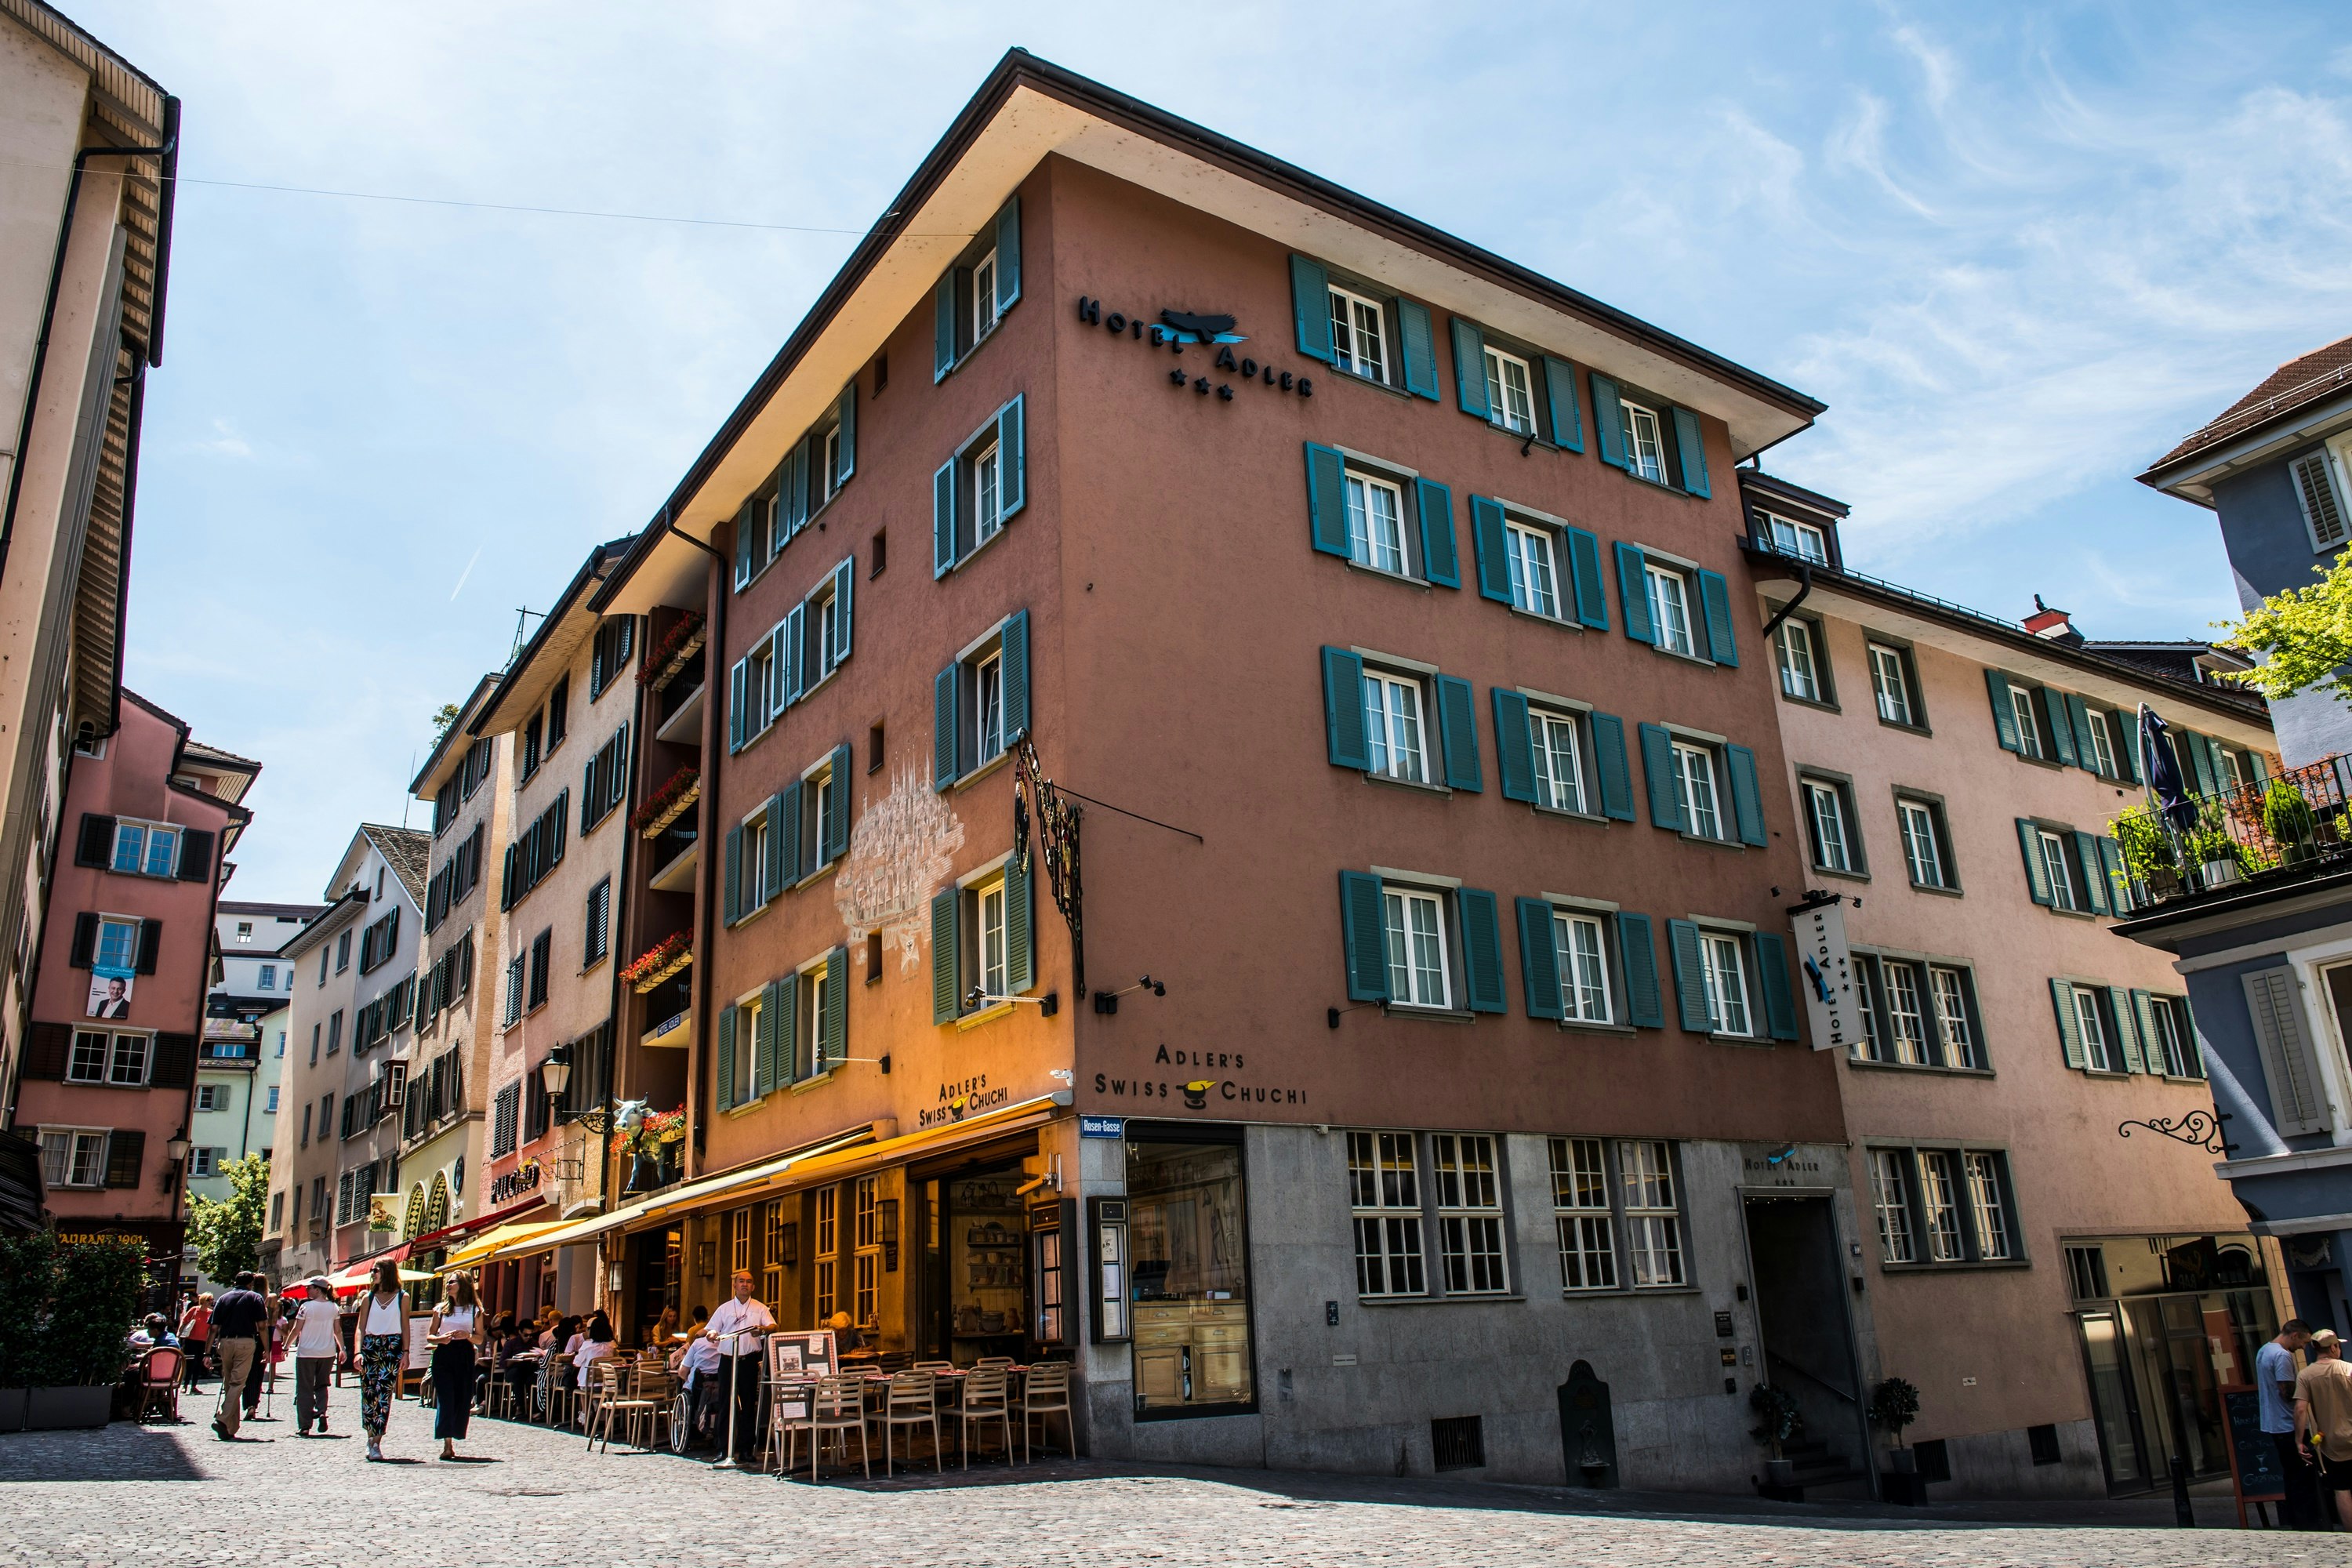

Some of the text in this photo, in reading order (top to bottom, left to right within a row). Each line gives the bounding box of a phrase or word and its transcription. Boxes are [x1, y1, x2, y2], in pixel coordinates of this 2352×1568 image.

[1079, 296, 1313, 398] HOTEL ADLER
[1813, 913, 1842, 1045] HOTEL ADLER
[1155, 1044, 1244, 1069] ADLER'S
[939, 1074, 986, 1102] ADLER'S
[1095, 1073, 1307, 1105] SWISS CHUCHI
[920, 1087, 1007, 1127] SWISS CHUCHI
[1083, 1119, 1120, 1133] Rosen-Gasse
[1744, 1157, 1819, 1171] HOTEL ADLER
